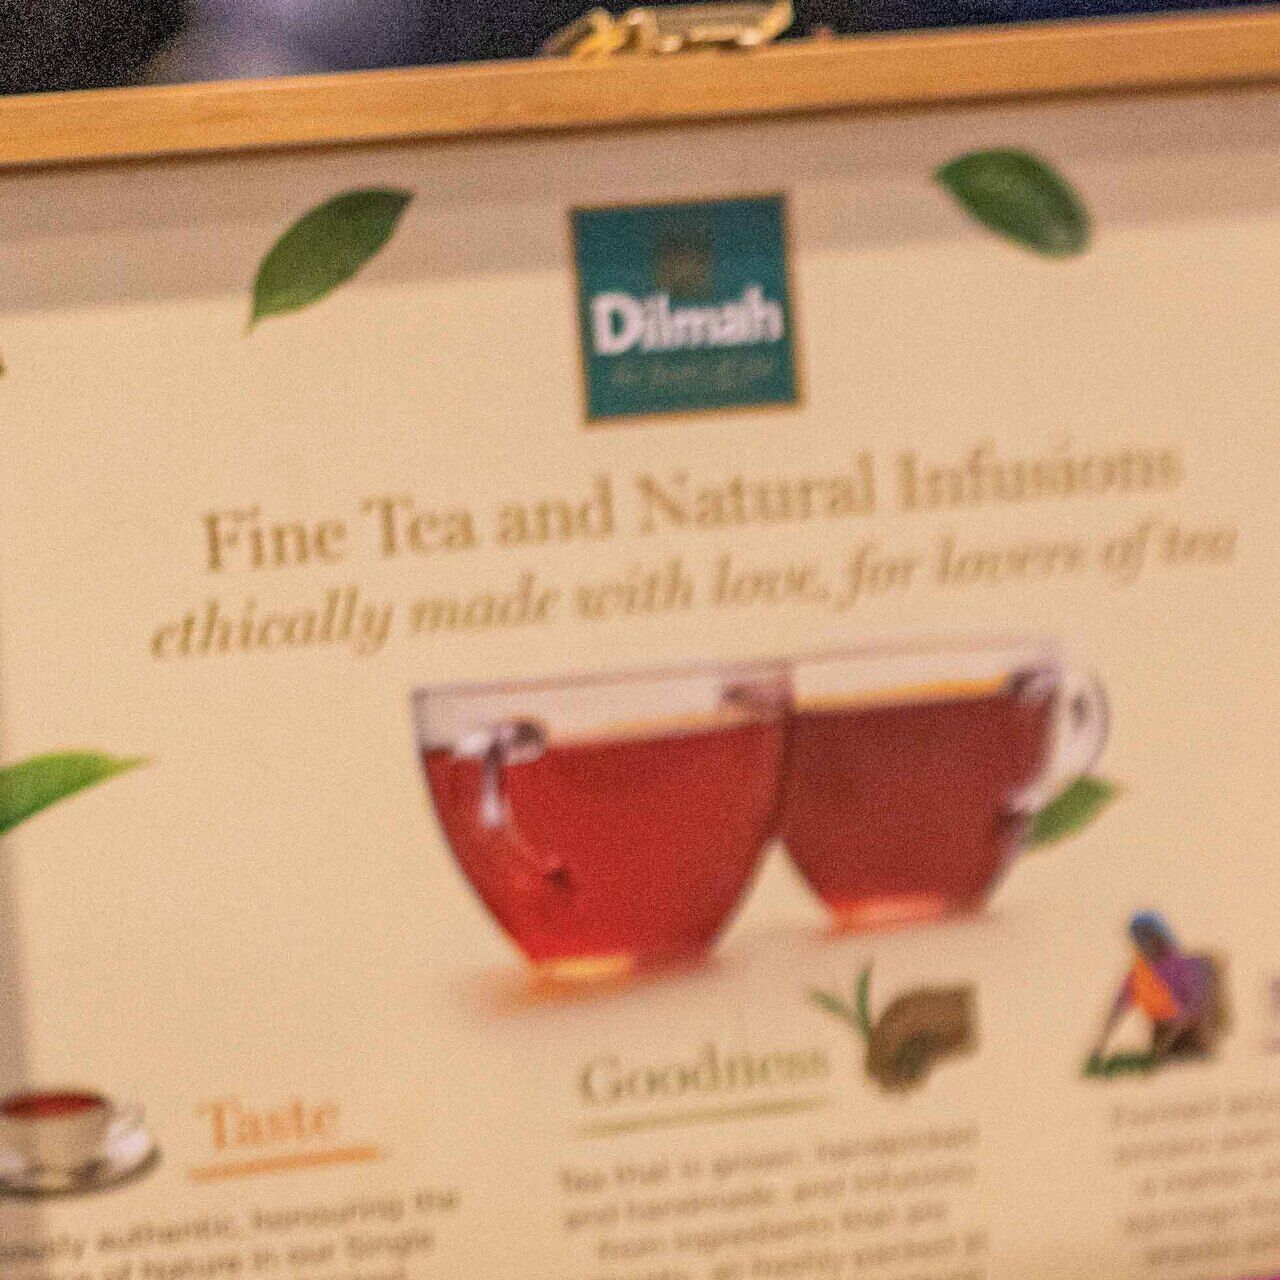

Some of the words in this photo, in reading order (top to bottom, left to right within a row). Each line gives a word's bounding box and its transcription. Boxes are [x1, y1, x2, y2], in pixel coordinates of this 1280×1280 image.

[591, 285, 785, 355] Dilmah
[203, 507, 349, 574] Fine
[359, 494, 478, 559] Tea
[500, 474, 614, 548] and
[634, 451, 875, 534] Natural
[897, 437, 1183, 514] Infusions
[150, 586, 394, 661] ethically
[406, 572, 561, 634] made
[572, 556, 694, 620] with
[838, 544, 918, 611] for
[934, 530, 1086, 588] lovers
[1100, 513, 1155, 586] of
[1162, 522, 1240, 566] tea
[577, 1041, 832, 1106] Goodness
[203, 1095, 341, 1151] Taste
